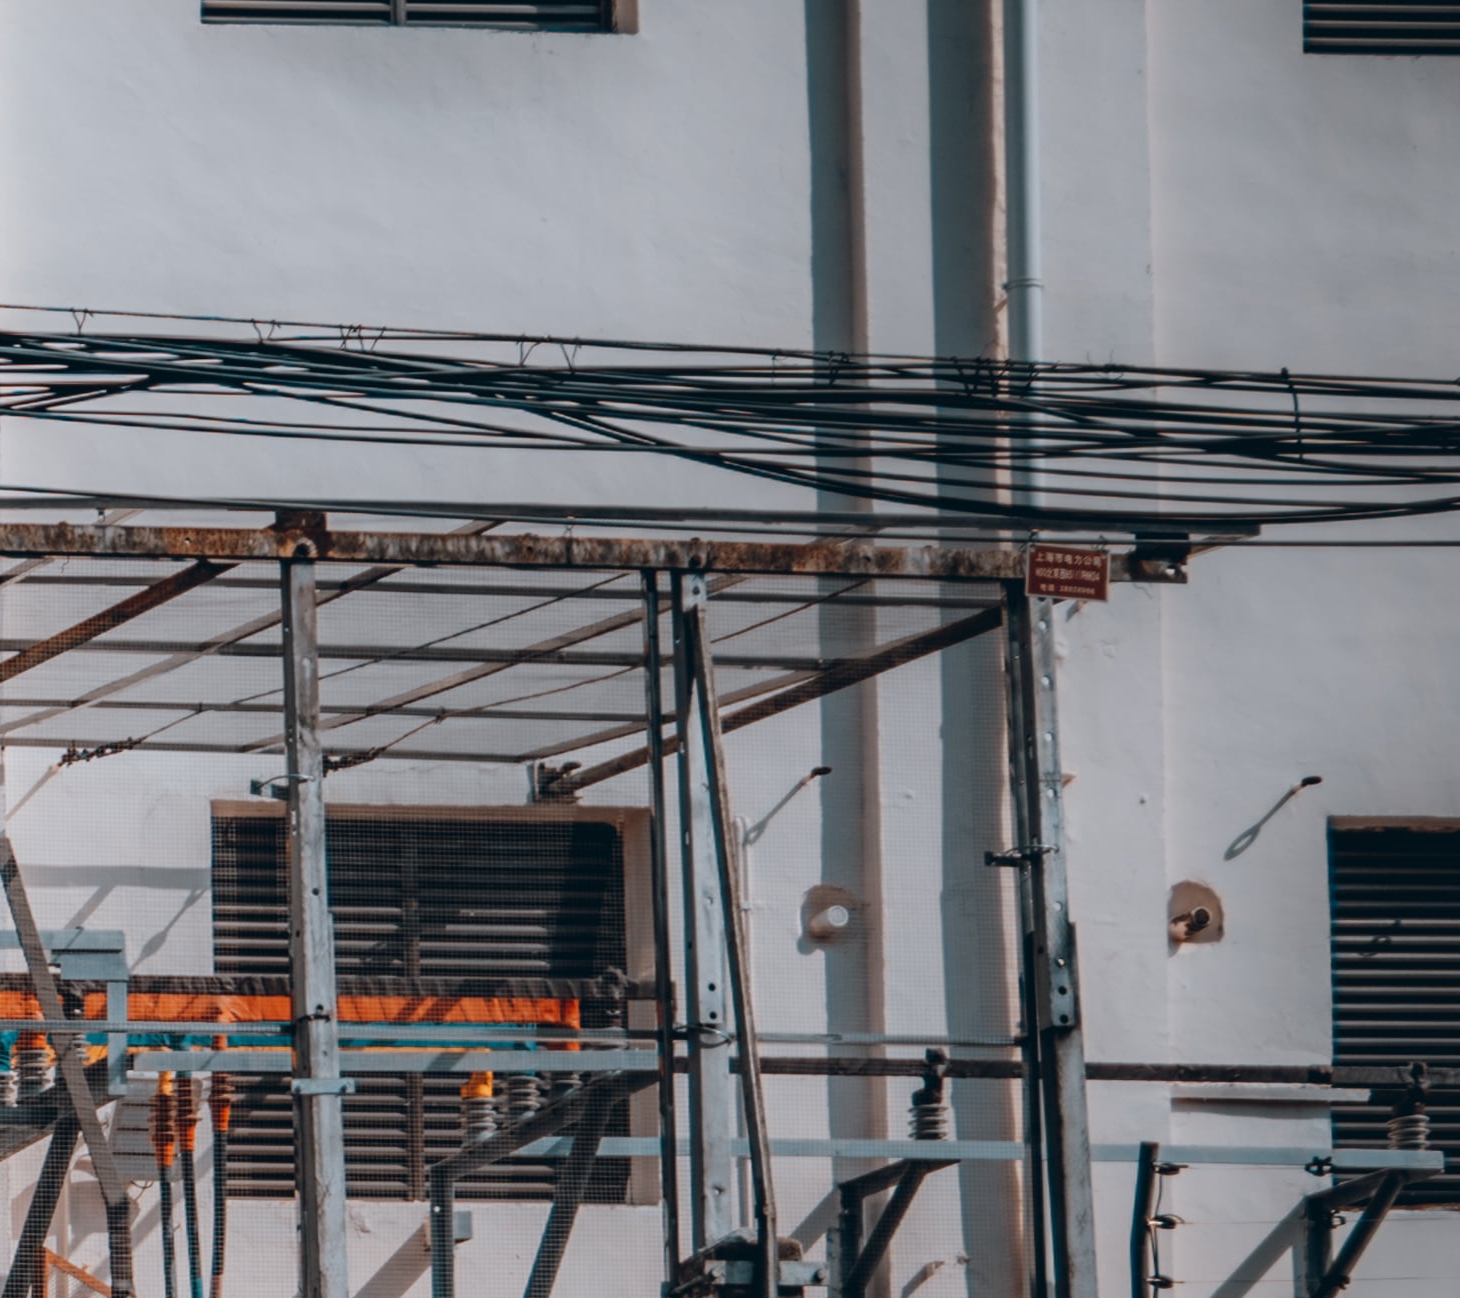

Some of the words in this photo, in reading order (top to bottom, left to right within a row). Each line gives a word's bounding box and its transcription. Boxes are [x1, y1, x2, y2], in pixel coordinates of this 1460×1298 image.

[1034, 551, 1101, 567] 上海市电力公司
